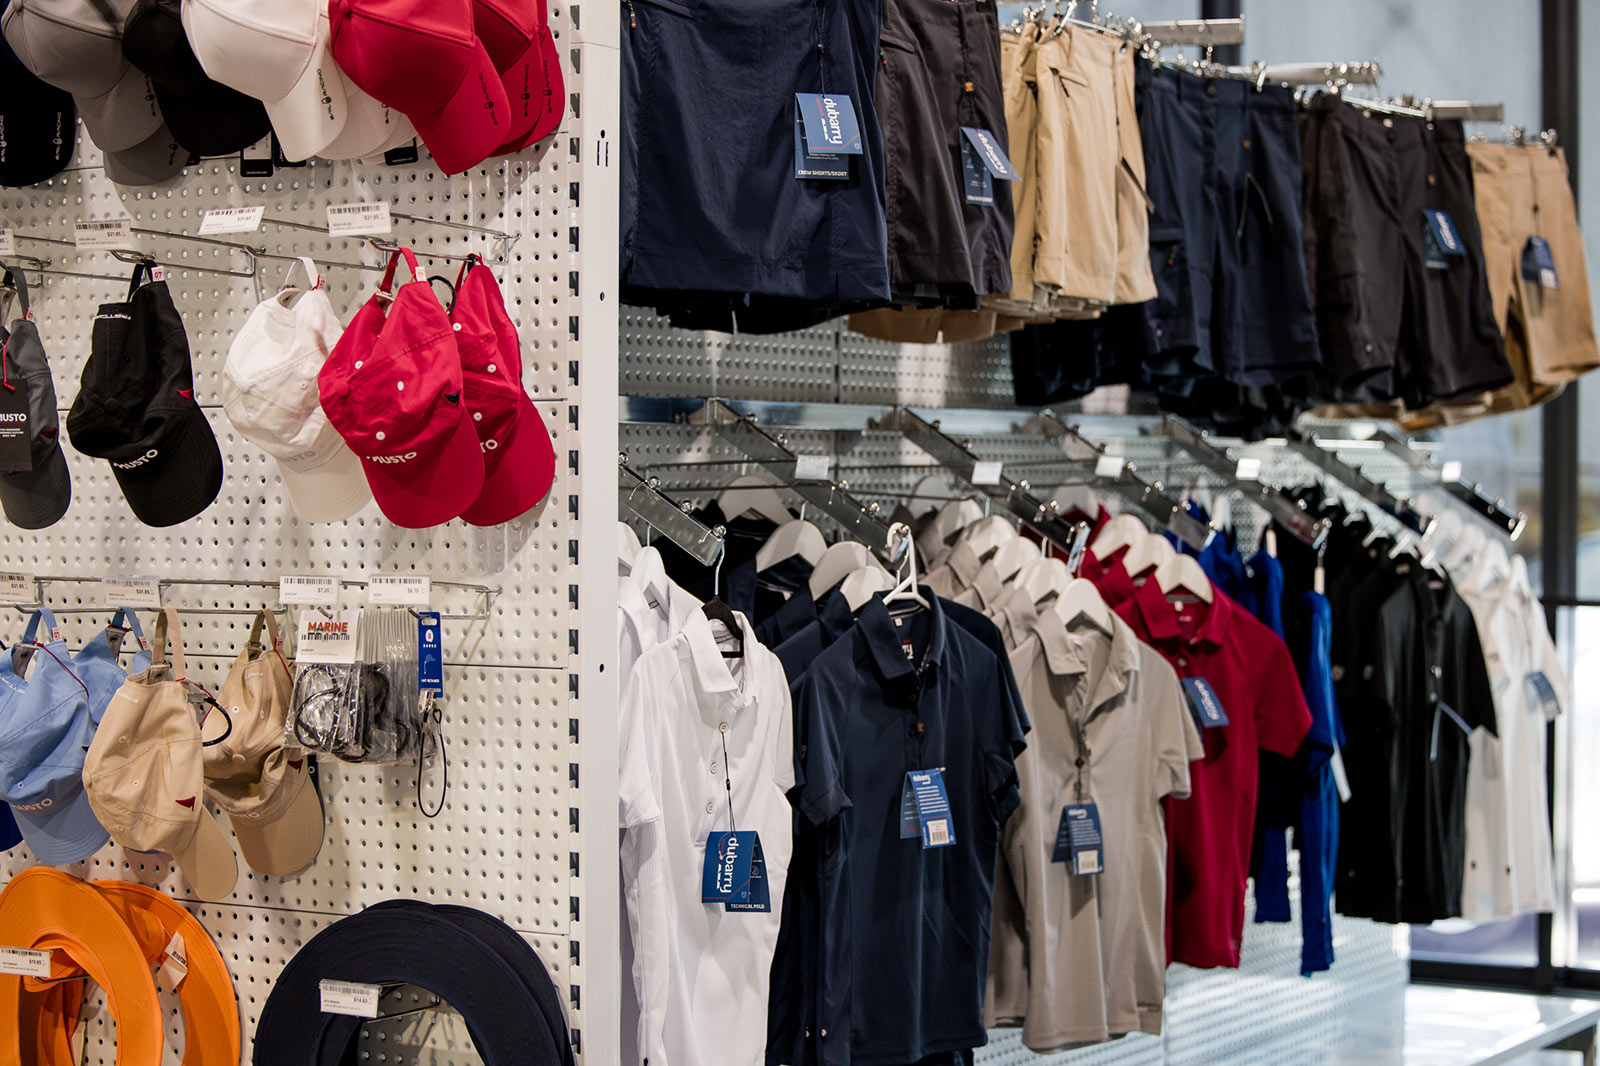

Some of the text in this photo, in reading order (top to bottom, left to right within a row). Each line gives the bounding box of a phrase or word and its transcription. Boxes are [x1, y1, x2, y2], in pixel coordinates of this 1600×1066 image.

[823, 98, 843, 145] dubarry
[977, 132, 1009, 174] dubarry
[154, 271, 163, 279] 07
[116, 449, 158, 469] MUSTO
[371, 452, 417, 464] MUSTO
[307, 621, 349, 632] MARINE
[719, 837, 740, 894] dubarry
